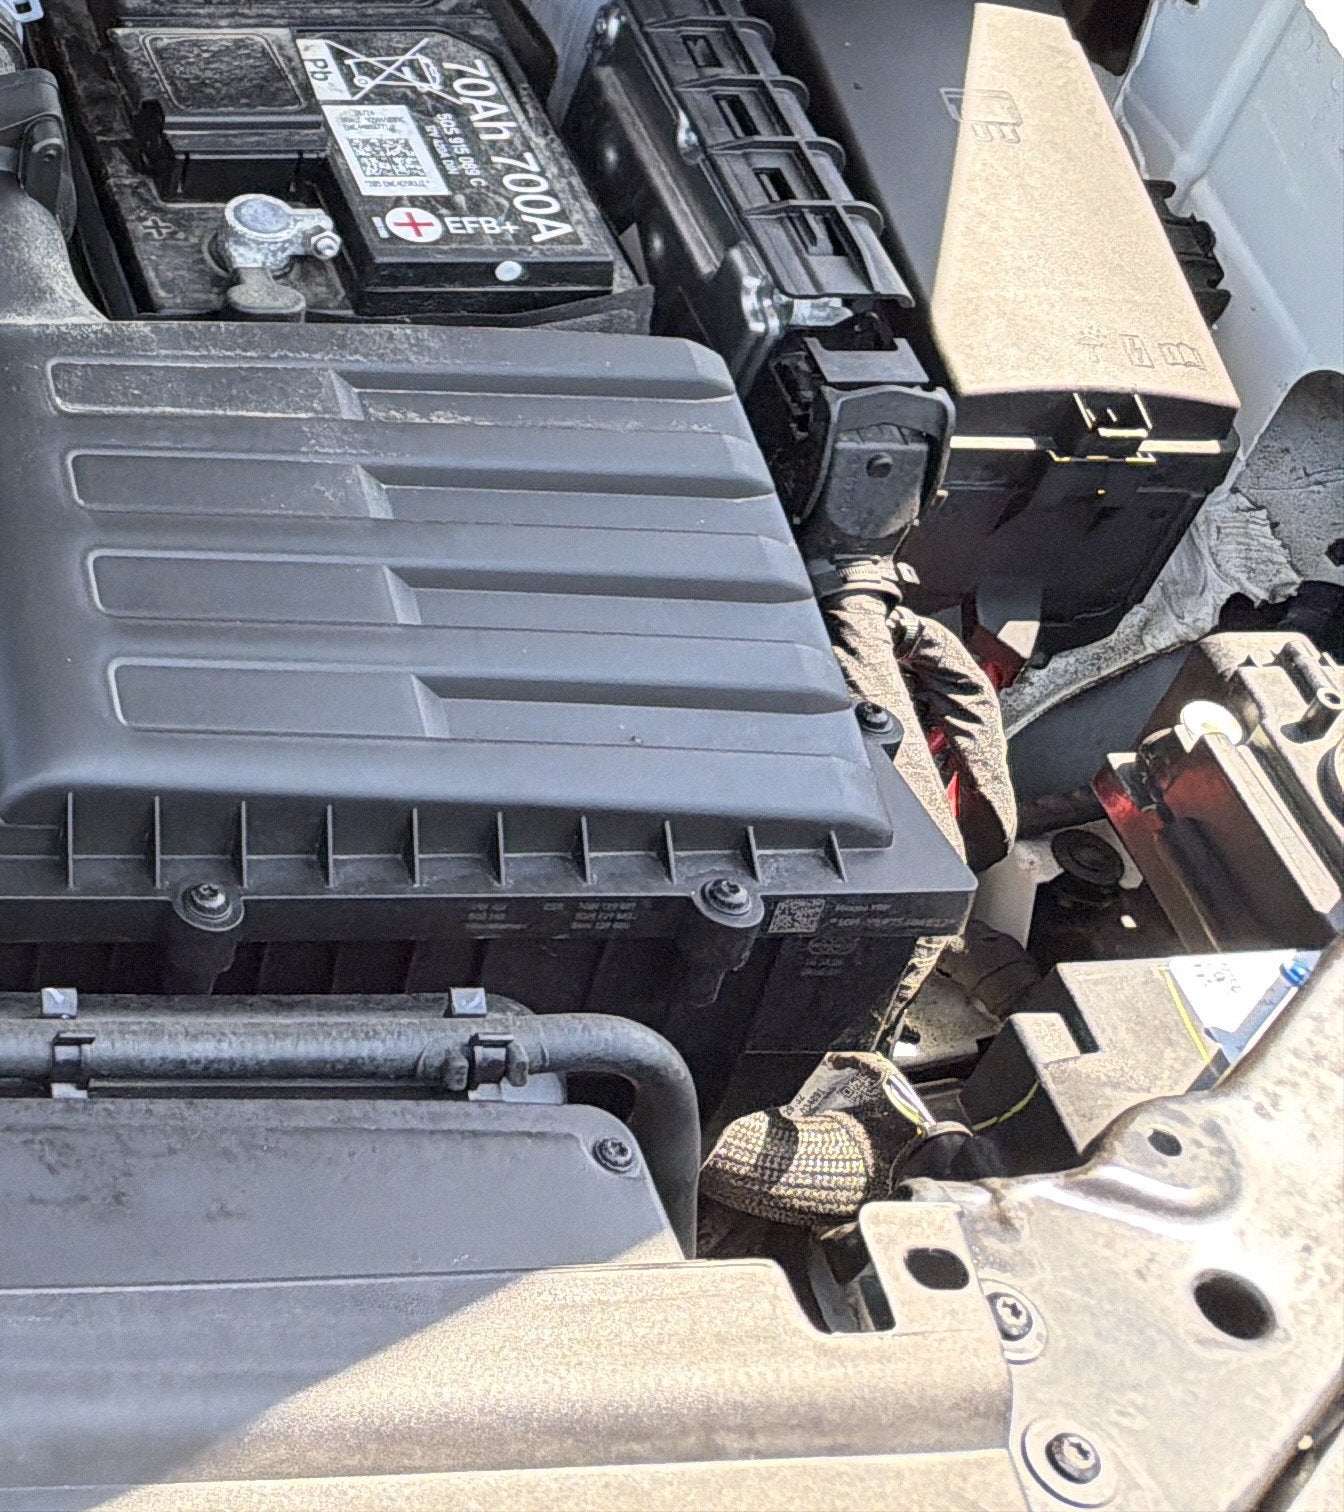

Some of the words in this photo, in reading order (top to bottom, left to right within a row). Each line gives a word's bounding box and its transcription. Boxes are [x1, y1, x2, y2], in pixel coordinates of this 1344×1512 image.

[305, 58, 329, 82] Pb
[442, 58, 518, 141] 70Ah
[490, 152, 575, 243] 700A
[444, 217, 519, 234] EFB+
